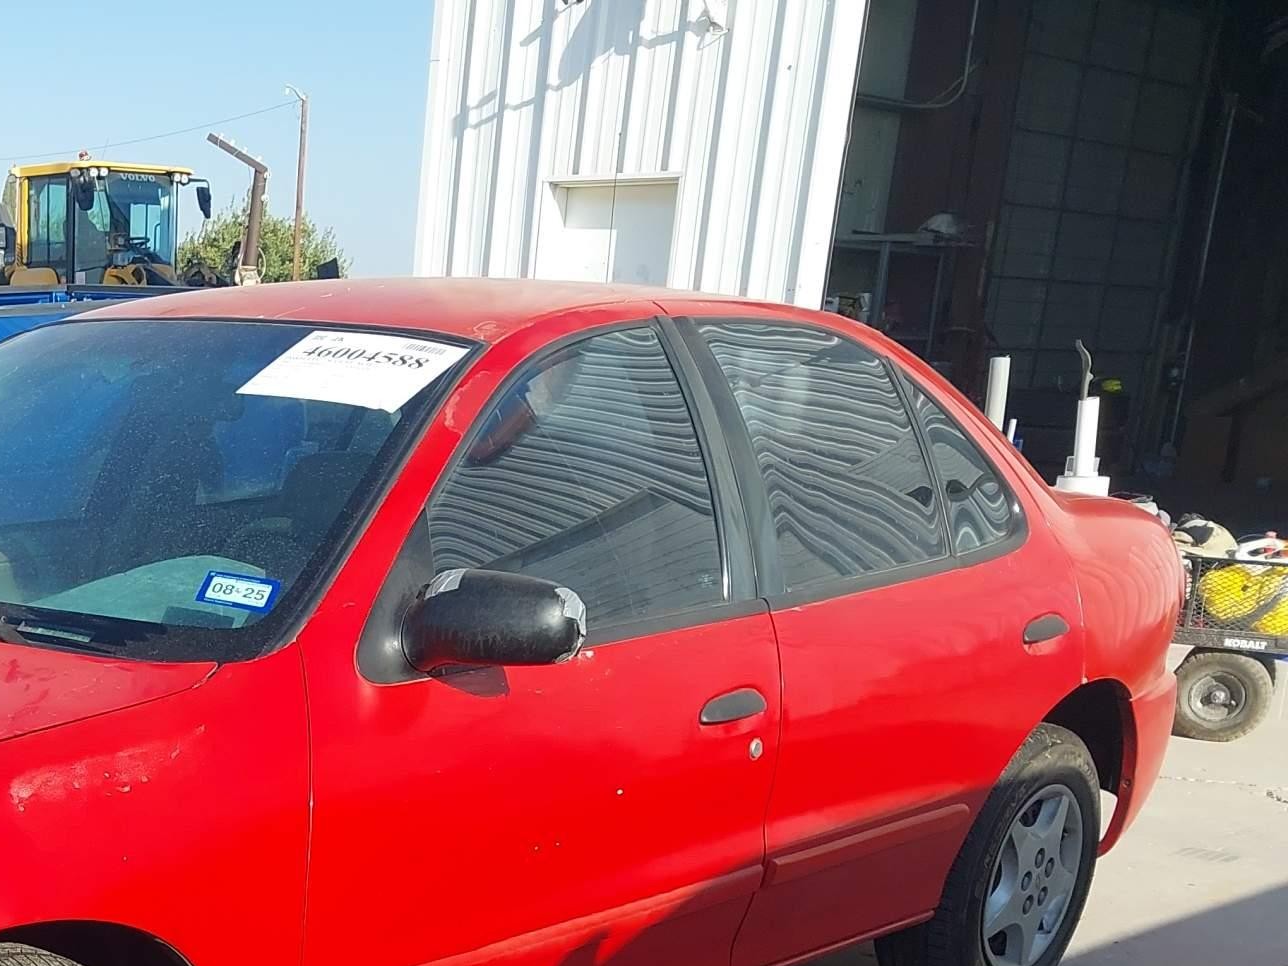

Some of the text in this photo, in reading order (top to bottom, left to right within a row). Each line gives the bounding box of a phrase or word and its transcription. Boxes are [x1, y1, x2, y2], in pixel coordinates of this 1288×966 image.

[120, 173, 156, 182] VOLVO
[303, 345, 430, 370] 46004588
[211, 582, 235, 596] 08
[242, 587, 266, 601] 25
[1223, 637, 1268, 650] KOBALT
